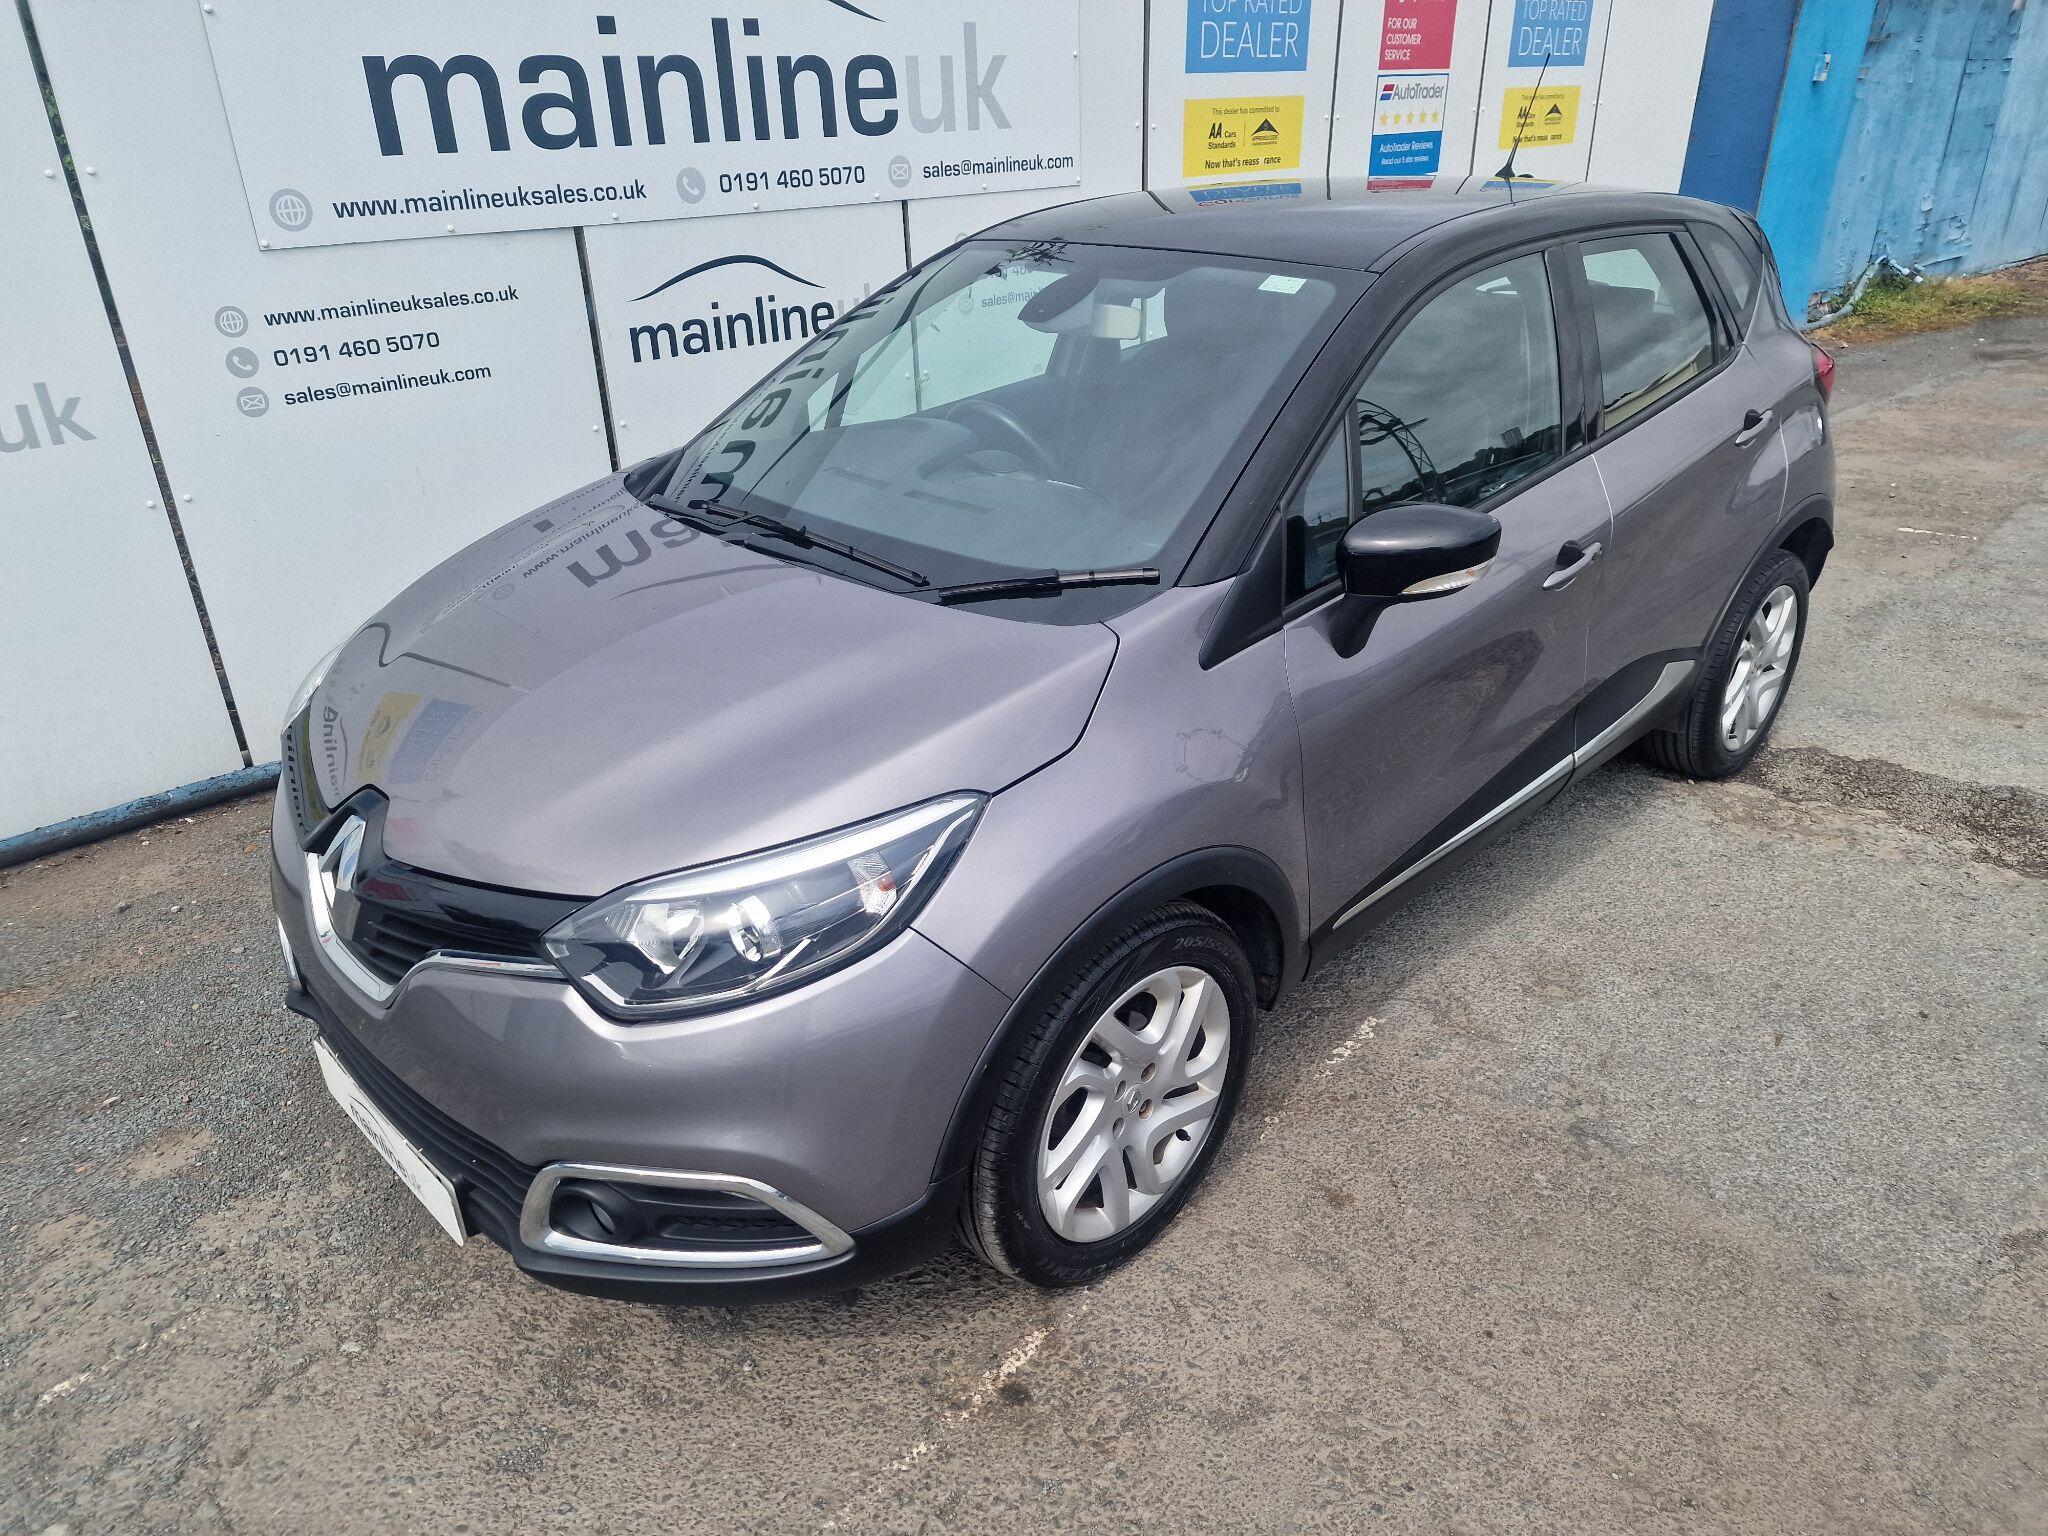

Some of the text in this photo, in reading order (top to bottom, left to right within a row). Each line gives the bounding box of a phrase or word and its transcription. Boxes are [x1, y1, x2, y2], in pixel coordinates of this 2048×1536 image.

[1524, 0, 1587, 21] TOP RATED
[1387, 17, 1418, 29] FOR OUR
[1200, 21, 1299, 59] DEALER
[1386, 33, 1422, 45] CUSTOMER
[1518, 26, 1583, 56] DEALER
[1384, 49, 1411, 61] SERVICE
[1392, 82, 1445, 101] AutoTrader
[1212, 107, 1223, 116] This
[1223, 107, 1239, 116] dealer
[1240, 107, 1249, 115] has
[1249, 105, 1274, 115] committed
[1208, 122, 1237, 140] AA Cars
[1207, 140, 1237, 150] Standards
[1379, 140, 1434, 153] AutoTrader Reviews
[923, 153, 1074, 180] sales@mainlineuk.com
[1204, 159, 1222, 170] Now
[1222, 157, 1241, 168] that's
[719, 165, 866, 194] 0191 460 5070
[332, 178, 648, 219] www.mainlineuksales.co.uk
[264, 284, 520, 327] www.mainlineuksales.co.uk
[273, 331, 441, 367] 0191 460 5070
[284, 366, 492, 406] sales@mainlineuk.com
